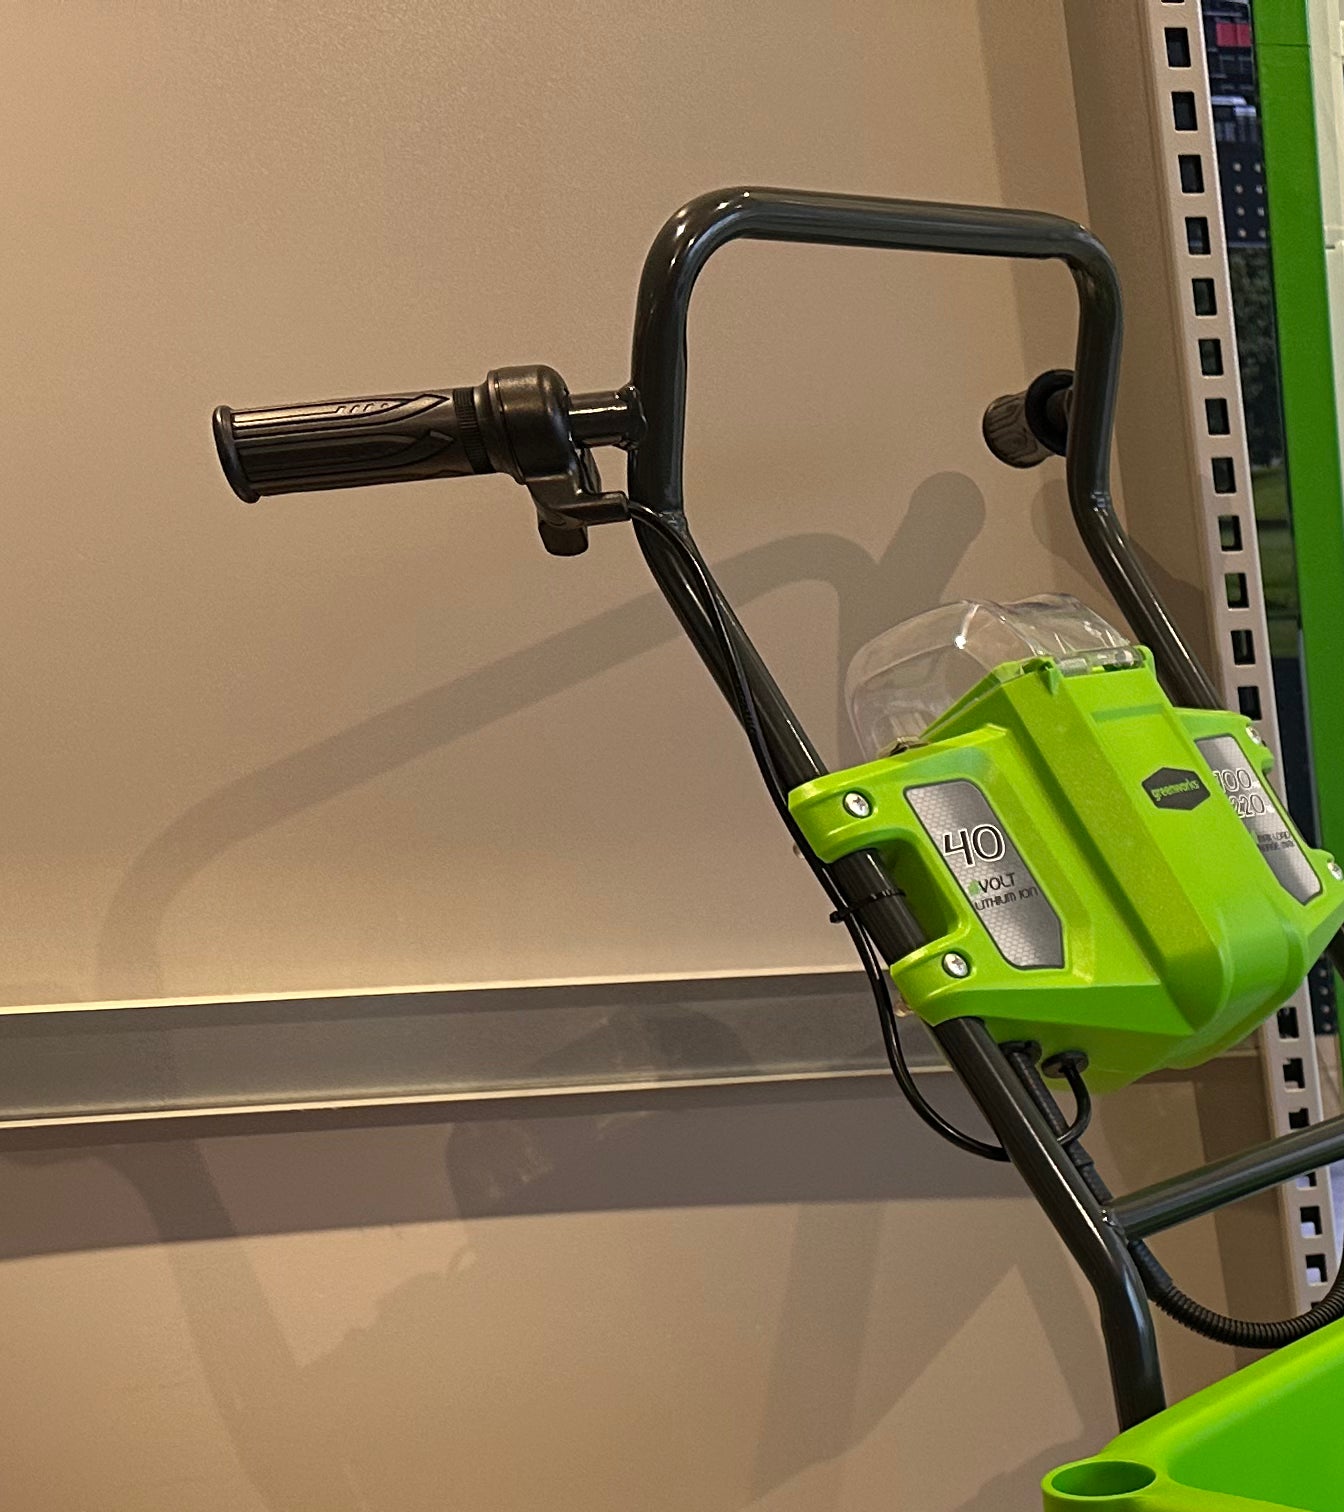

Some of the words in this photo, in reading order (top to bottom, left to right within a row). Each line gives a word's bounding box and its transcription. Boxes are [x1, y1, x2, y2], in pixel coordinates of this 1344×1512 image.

[1151, 778, 1200, 802] greenworks
[943, 824, 1005, 867] 40
[978, 872, 1015, 893] VOLT
